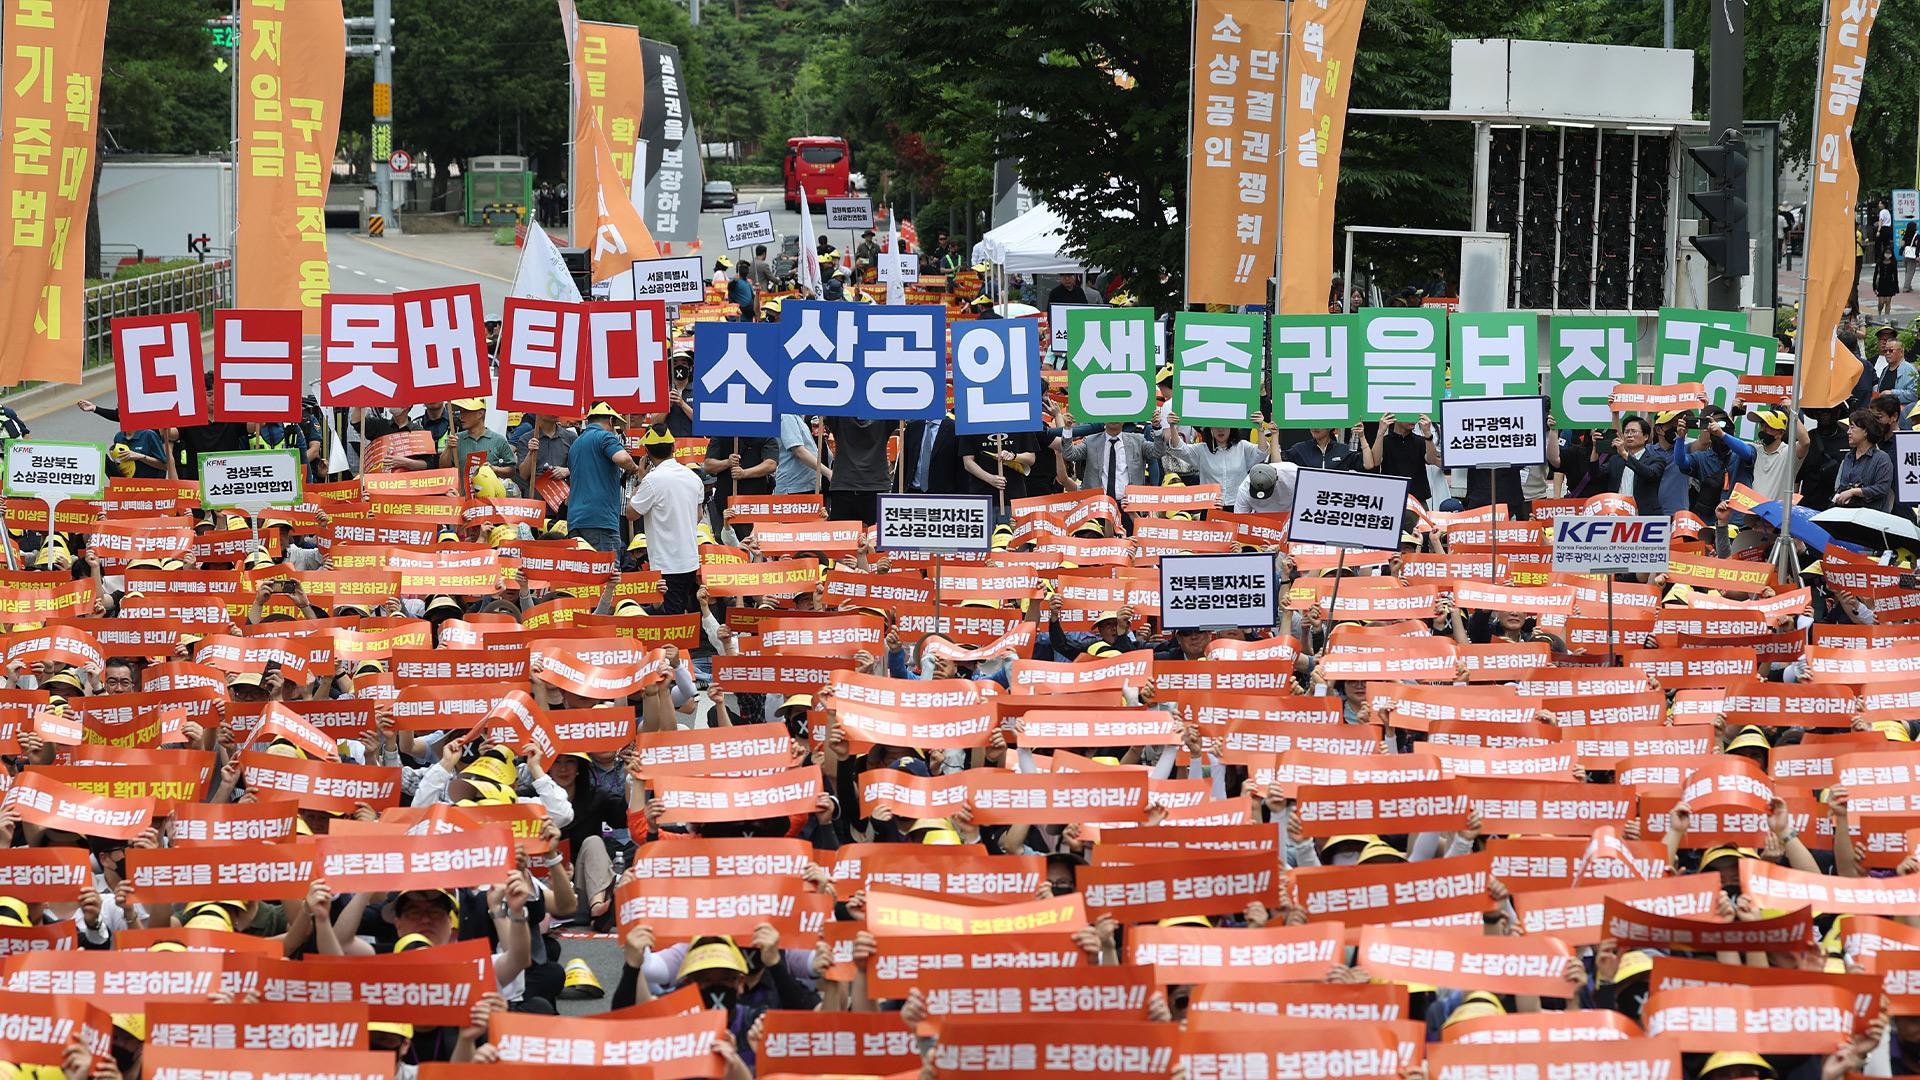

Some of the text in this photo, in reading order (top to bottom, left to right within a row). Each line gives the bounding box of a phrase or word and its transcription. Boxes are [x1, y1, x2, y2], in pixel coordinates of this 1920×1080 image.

[1204, 14, 1242, 168] 소상공인
[647, 270, 689, 282] 서울특별시
[639, 281, 698, 294] 소상공인연합회
[700, 310, 1030, 422] 소상공인
[1072, 317, 1436, 420] 생존권을
[1462, 416, 1524, 432] 대구광역시
[1450, 434, 1537, 450] 소상공인연합회
[31, 455, 78, 469] 경상북도
[206, 458, 227, 466] KFME
[12, 471, 95, 486] 소상공인연합회
[226, 465, 273, 479] 경상북도
[210, 480, 293, 495] 소상공인연합회
[383, 504, 411, 514] 이상은
[731, 503, 819, 515] 생존권을 보장하라!!
[1318, 490, 1384, 511] 광주광역시
[885, 507, 984, 523] 전북특별자치도
[1300, 509, 1396, 531] 소상공인연합회
[335, 526, 432, 545] 최저임금 구분적용!!
[885, 523, 984, 540] 소상공인연합회
[1138, 527, 1232, 542] 생존권을 보장하라!!
[1449, 531, 1486, 544] 최저임금
[1557, 522, 1668, 543] KFME
[90, 533, 189, 551] 최저임금 구분적용!!
[1556, 552, 1667, 564] 광주광역시 소상공인연합회
[706, 572, 783, 586] 근로기준법 확대
[1404, 563, 1447, 577] 최저임금
[128, 580, 236, 593] 대형마트 새벽배송 반대!!
[339, 583, 397, 595] 전환하라!!
[982, 575, 1039, 588] 보장하라!!
[1170, 574, 1266, 592] 전북특별자치도
[827, 581, 928, 602] 생존권을 보장하라!!
[1063, 587, 1112, 602] 생존권을
[1457, 589, 1573, 608] 생존권을 보장하라!!
[1170, 593, 1266, 610] 소상공인연합회
[1320, 596, 1434, 611] 생존권을 보장하라!!
[97, 631, 177, 644] 새벽배송 반대!!
[763, 629, 880, 647] 생존권을 보장하라!!
[7, 637, 51, 659] 생존권을
[397, 661, 524, 678] 생존권을 보장하라!!
[1386, 656, 1456, 671] 보장하라!!
[1483, 655, 1547, 668] 보장하라!!
[1688, 660, 1753, 675] 보장하라!!
[1812, 659, 1867, 673] 생존권을
[718, 667, 776, 682] 생존권을
[1017, 661, 1147, 684] 생존권을 보장하라!!
[1157, 673, 1287, 689] 생존권을 보장하라!!
[835, 682, 977, 708] 생존권을 보장하라!!
[1517, 682, 1574, 696] 생존권을
[1397, 701, 1455, 720] 생존권을
[1724, 697, 1856, 714] 생존권을 보장하라!!
[554, 721, 629, 739] 보장하라!!
[844, 713, 990, 739] 생존권을 보장하라!!
[1024, 722, 1174, 737] 생존권을 보장하라!!
[1225, 733, 1292, 751] 생존권을
[1634, 738, 1708, 756] 보장하라!!
[639, 738, 789, 768] 생존권을 보장하라!!
[1491, 755, 1570, 774] 보장하라!!
[245, 766, 394, 799] 생존권을 보장하라!!
[1840, 766, 1909, 786] 생존권을
[661, 780, 815, 809] 생존권을 보장하라!!
[864, 782, 926, 806] 생존권을
[974, 787, 1141, 808] 생존권을 보장하라!!
[57, 799, 146, 827] 보장하라!!
[1300, 795, 1467, 821] 생존권을 보장하라!!
[1542, 799, 1630, 821] 보장하라!!
[213, 817, 293, 841] 보장하라!!
[323, 847, 508, 875] 생존권을 보장하라!!
[635, 855, 808, 879] 생존권을 보장하라!!
[1491, 856, 1568, 878] 생존권을
[134, 861, 313, 887] 생존권을 보장하라!!
[1085, 871, 1271, 907] 생존권을 보장하라!!
[1306, 871, 1486, 914] 생존권을 보장하라!!
[695, 895, 795, 918] 보장하라!!
[1523, 903, 1604, 933] 생존권을
[1135, 940, 1336, 967] 생존권을 보장하라!!
[1369, 943, 1568, 977] 생존권을 보장하라!!
[8, 971, 212, 994] 생존권을 보장하라!!
[264, 976, 471, 1007] 생존권을 보장하라!!
[928, 985, 1147, 1015] 생존권을 보장하라!!
[1744, 1007, 1853, 1033] 보장하라!!
[151, 1022, 358, 1051] 생존권을 보장하라!!
[766, 1032, 856, 1057] 생존권을
[498, 1031, 717, 1067] 생존권을 보장하라!!
[934, 1043, 1172, 1073] 생존권을 보장하라!!
